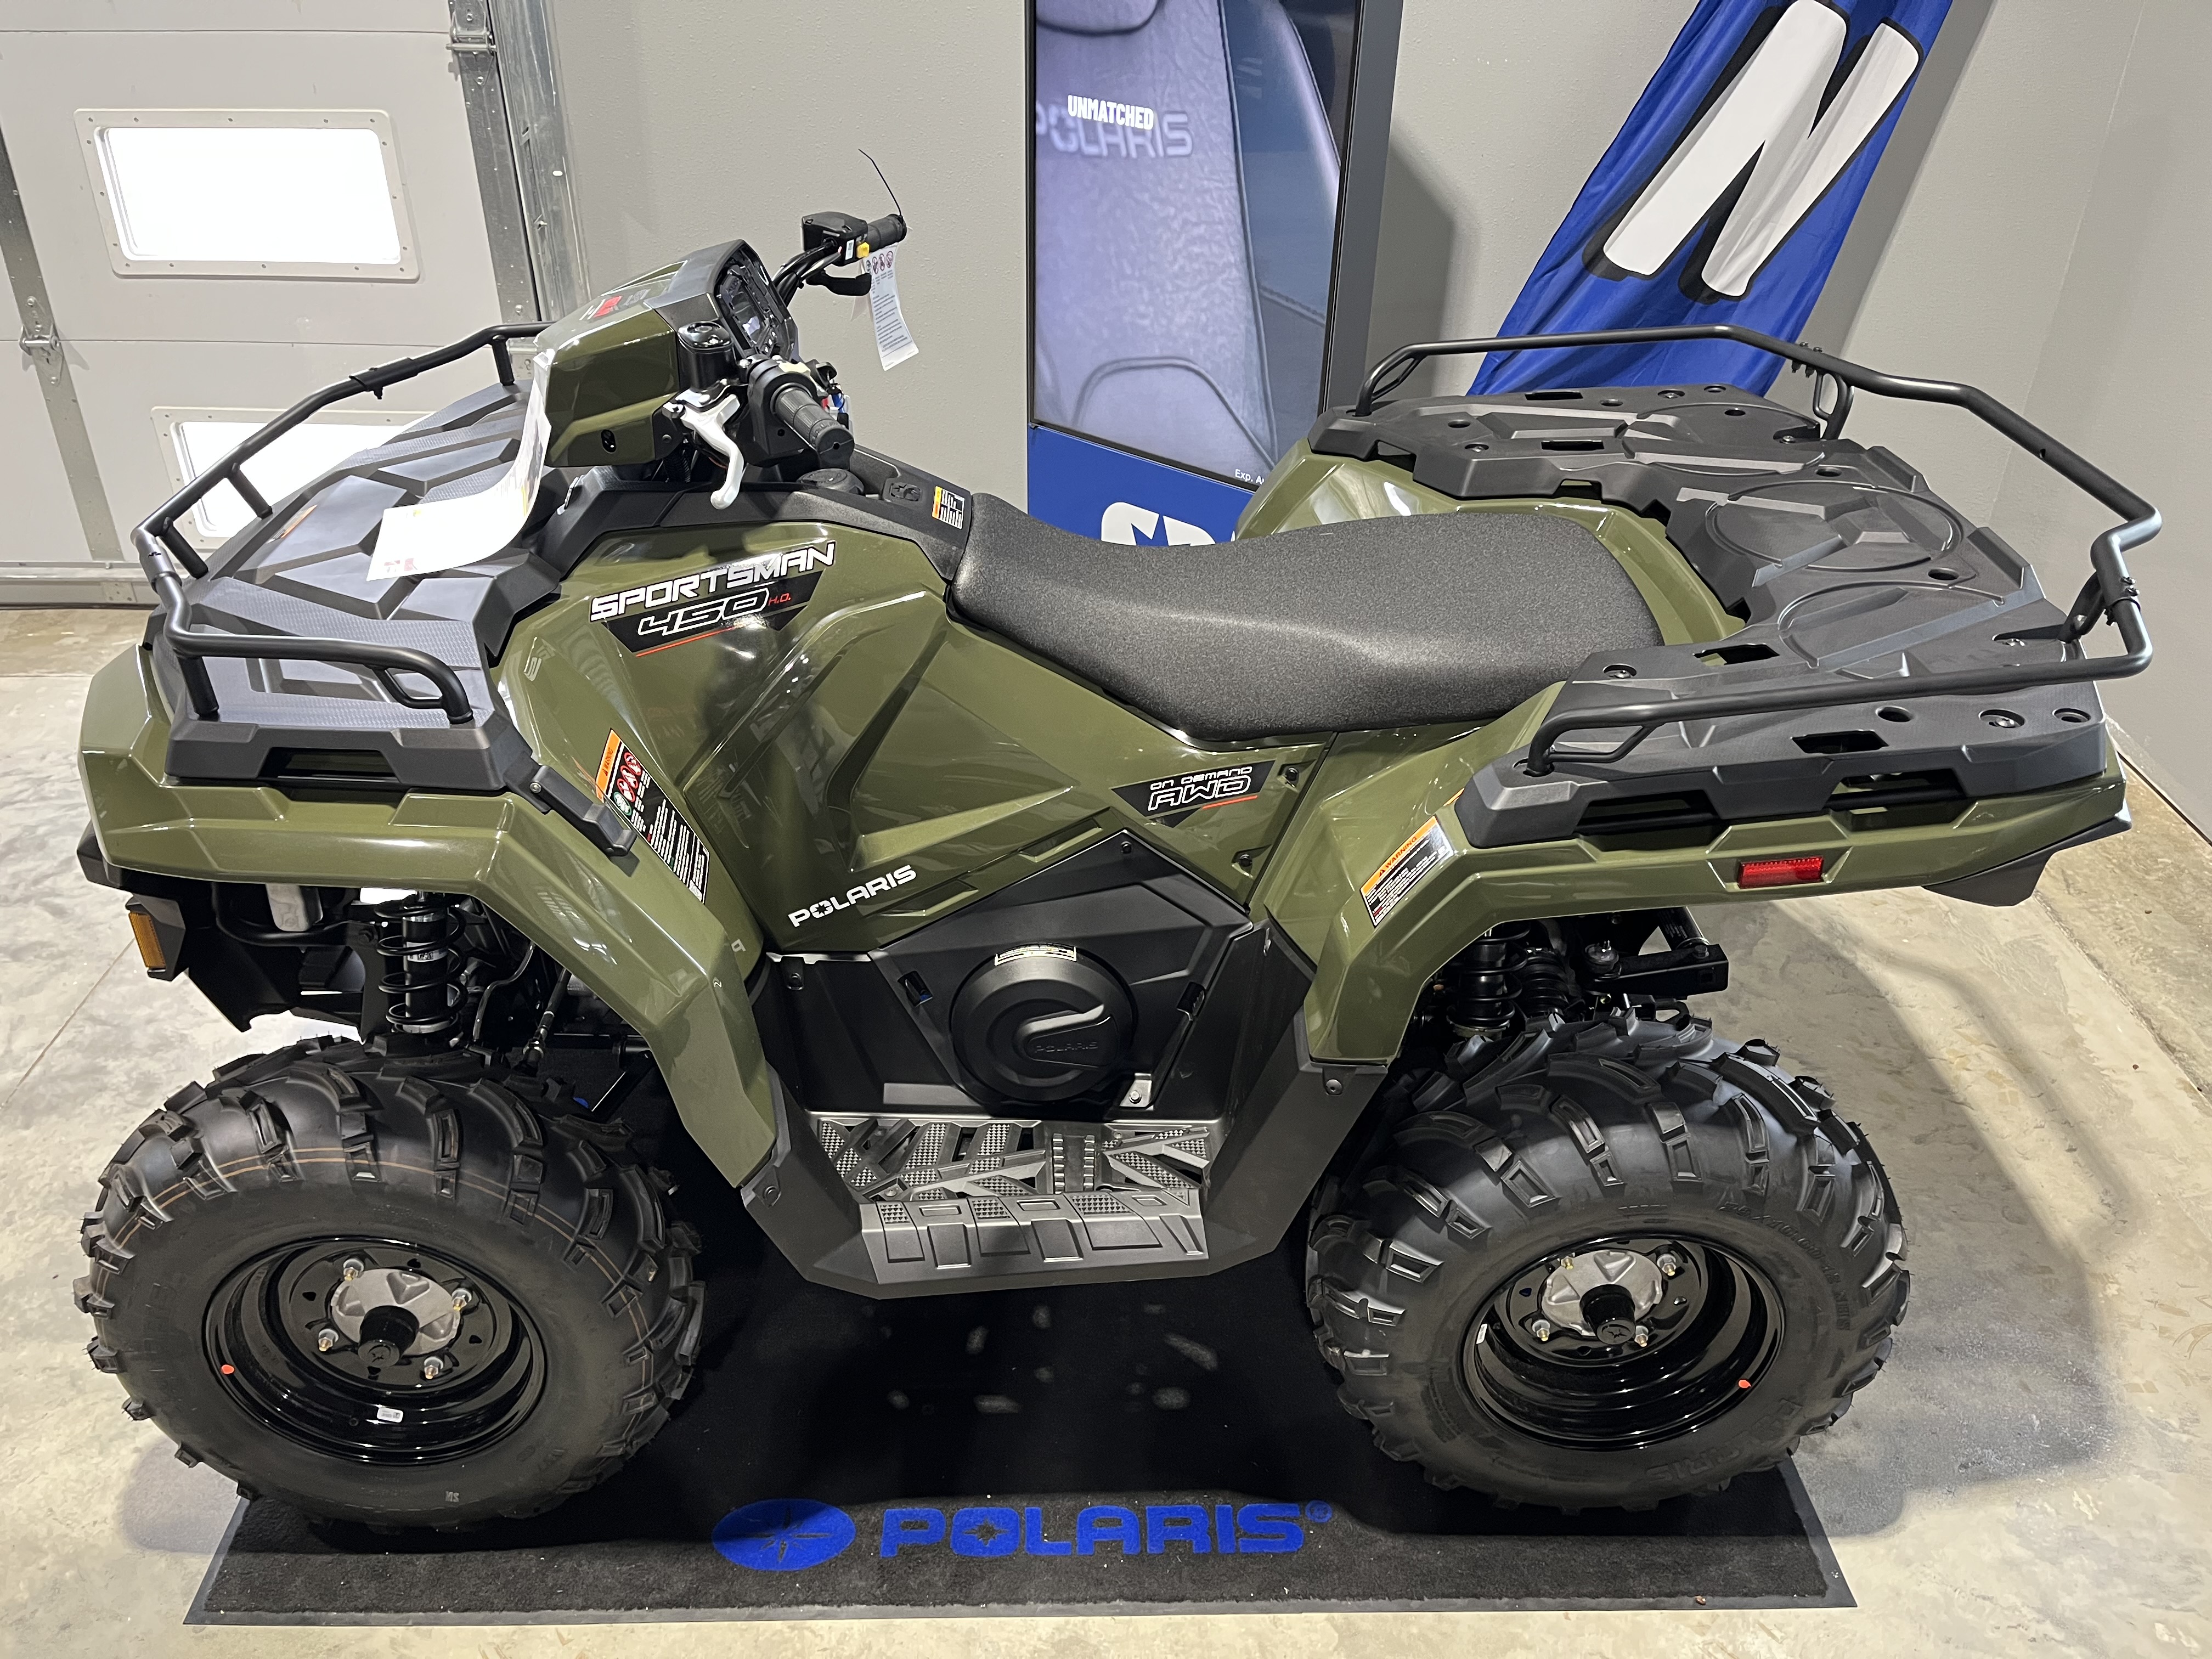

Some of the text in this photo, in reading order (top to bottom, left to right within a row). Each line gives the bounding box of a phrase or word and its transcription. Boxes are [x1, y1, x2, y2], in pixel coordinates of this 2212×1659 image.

[1068, 95, 1154, 129] UNMATCHED
[1235, 469, 1253, 482] Exp.
[590, 542, 836, 622] SPORTSMAN
[637, 588, 791, 636] 450 H.O.
[1148, 775, 1251, 811] AWD
[1385, 836, 1418, 868] WARNING
[788, 865, 917, 928] POLARIS
